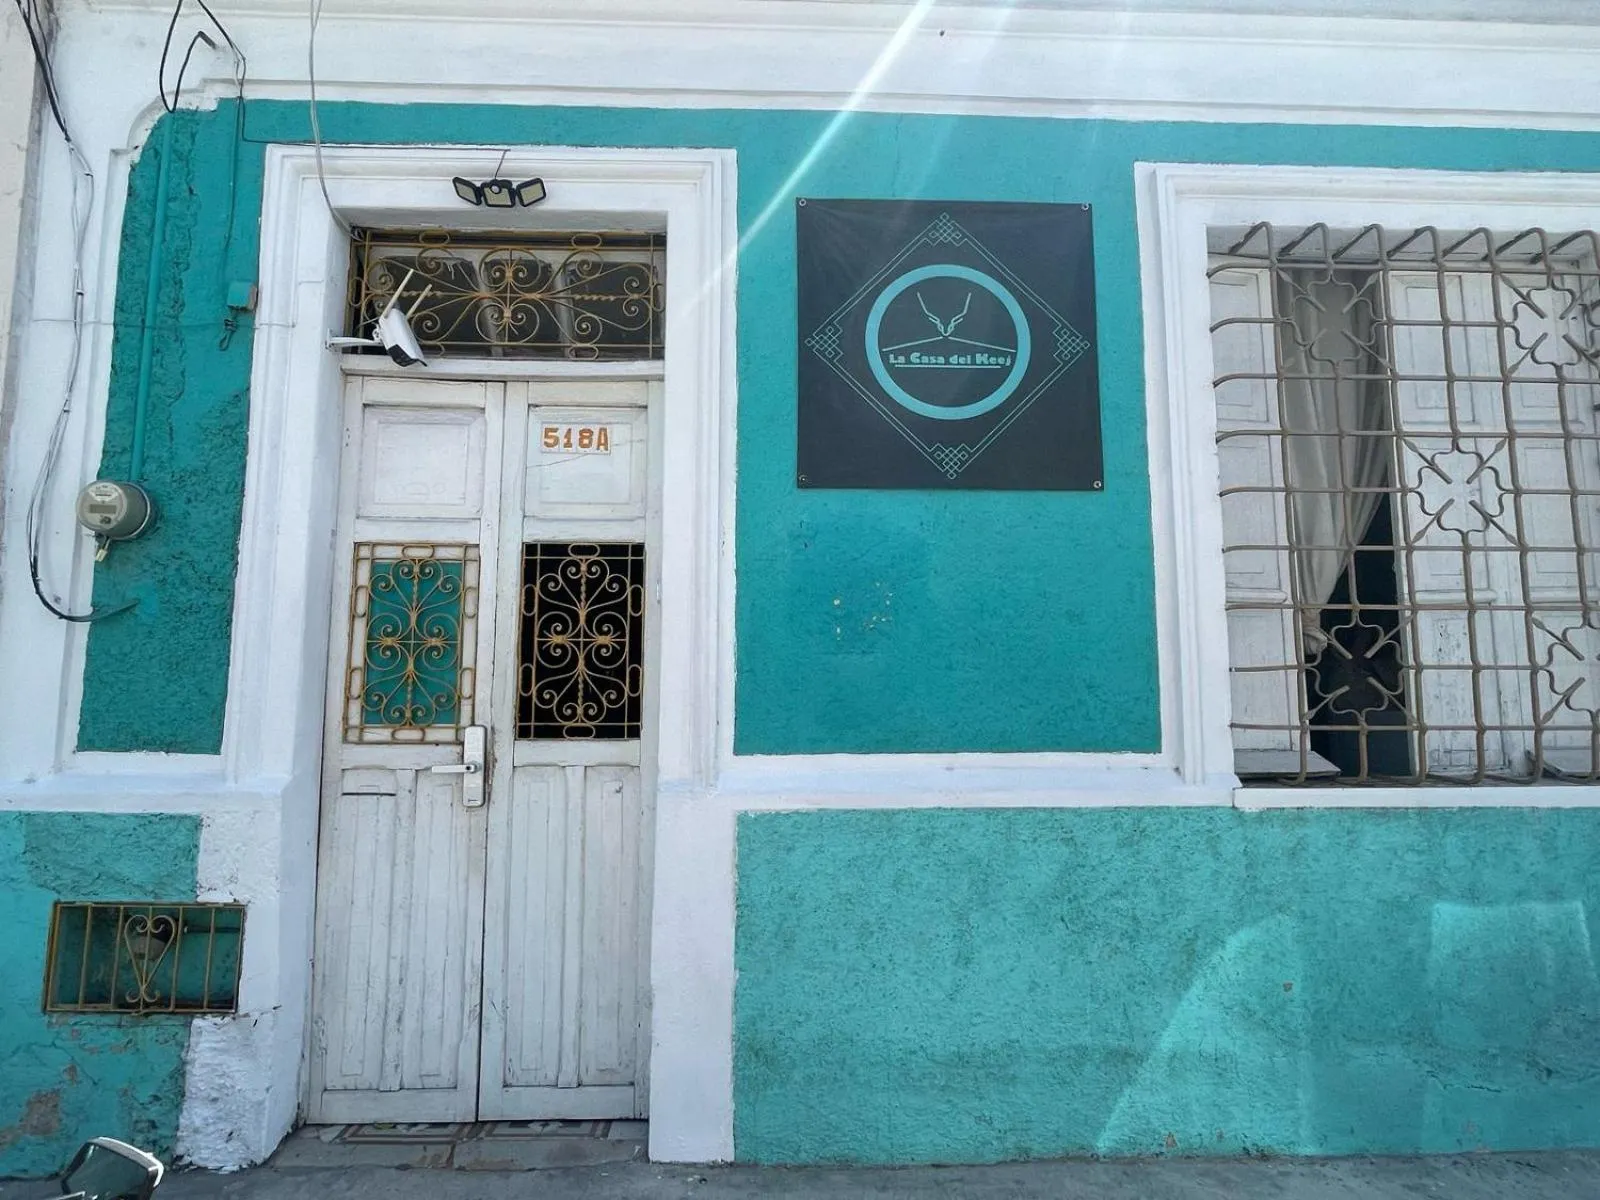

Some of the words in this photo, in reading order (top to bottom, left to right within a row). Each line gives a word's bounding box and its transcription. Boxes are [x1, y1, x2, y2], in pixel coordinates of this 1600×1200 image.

[889, 353, 906, 364] La
[910, 352, 944, 365] Casa
[949, 354, 971, 365] del
[544, 427, 608, 451] 518A
